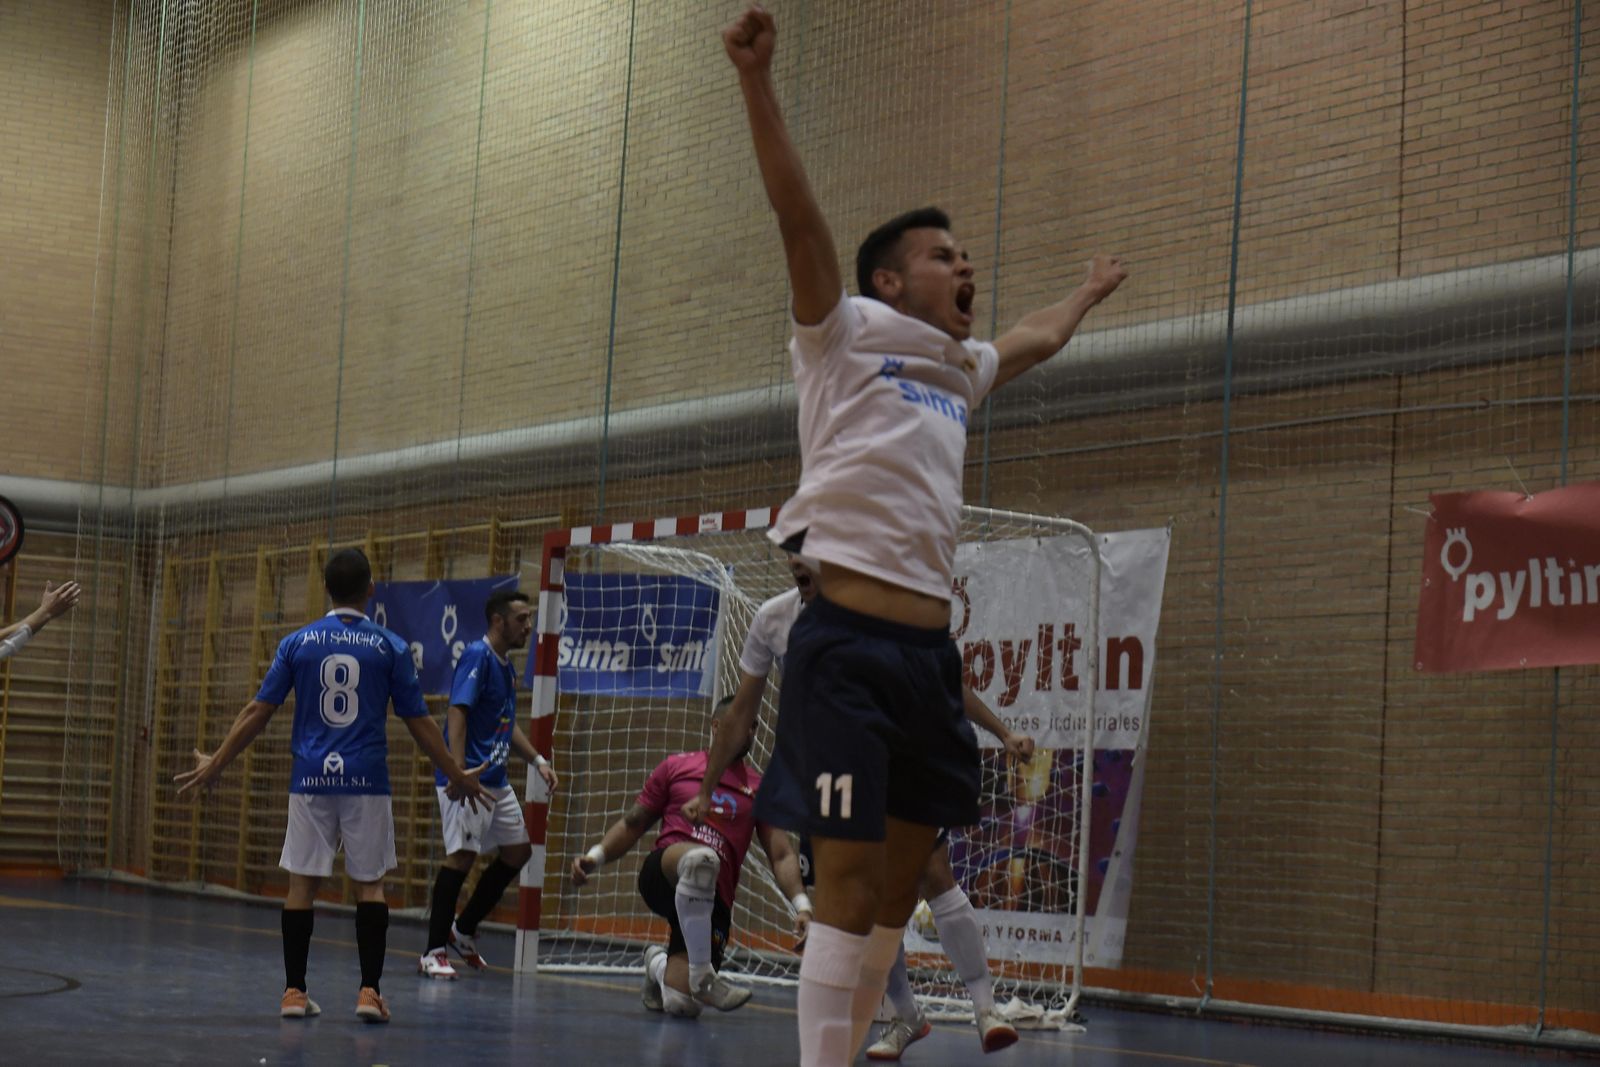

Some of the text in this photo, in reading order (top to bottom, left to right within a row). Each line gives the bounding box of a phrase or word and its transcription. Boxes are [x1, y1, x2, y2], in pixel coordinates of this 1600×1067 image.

[319, 653, 361, 729] 8
[962, 623, 1143, 707] pyltn
[815, 772, 853, 819] 11
